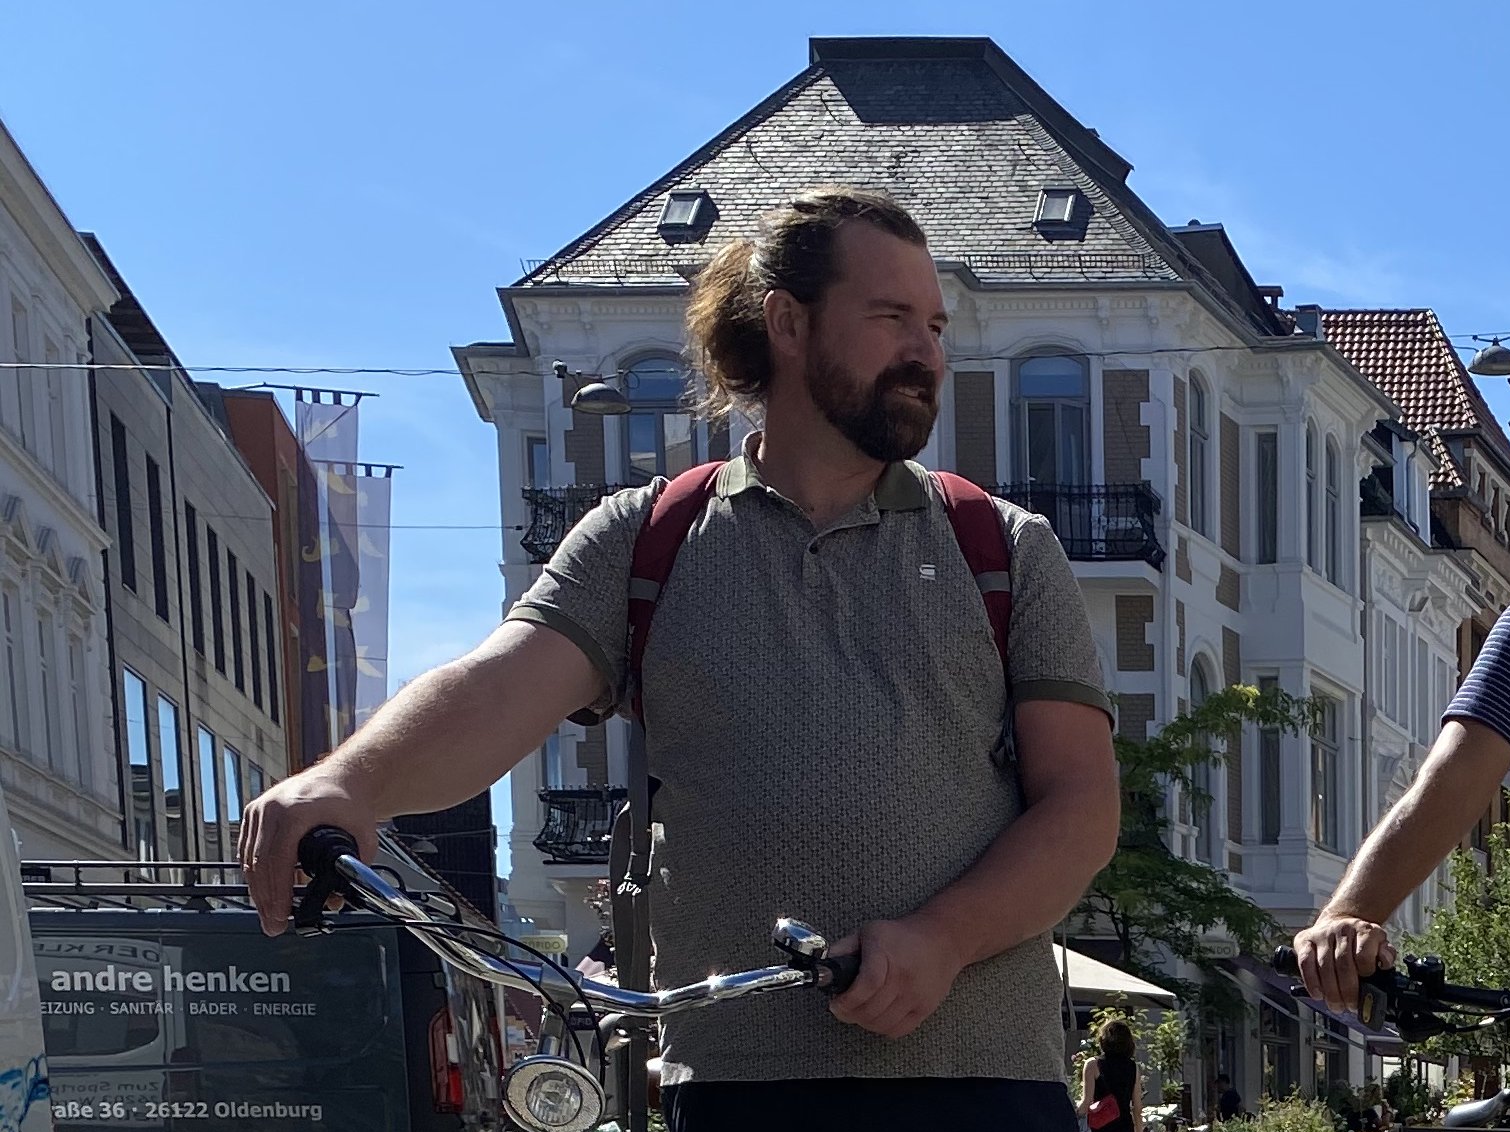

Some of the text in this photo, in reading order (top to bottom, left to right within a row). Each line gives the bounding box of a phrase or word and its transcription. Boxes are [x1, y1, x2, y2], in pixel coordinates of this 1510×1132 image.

[51, 965, 291, 993] andre henken
[110, 1000, 174, 1015] SANITÄR
[189, 1000, 238, 1015] BÄDER
[253, 1003, 317, 1016] ENERGIE
[100, 1101, 125, 1119] 36
[145, 1101, 209, 1119] 26122
[214, 1101, 323, 1122] Oldenburg
